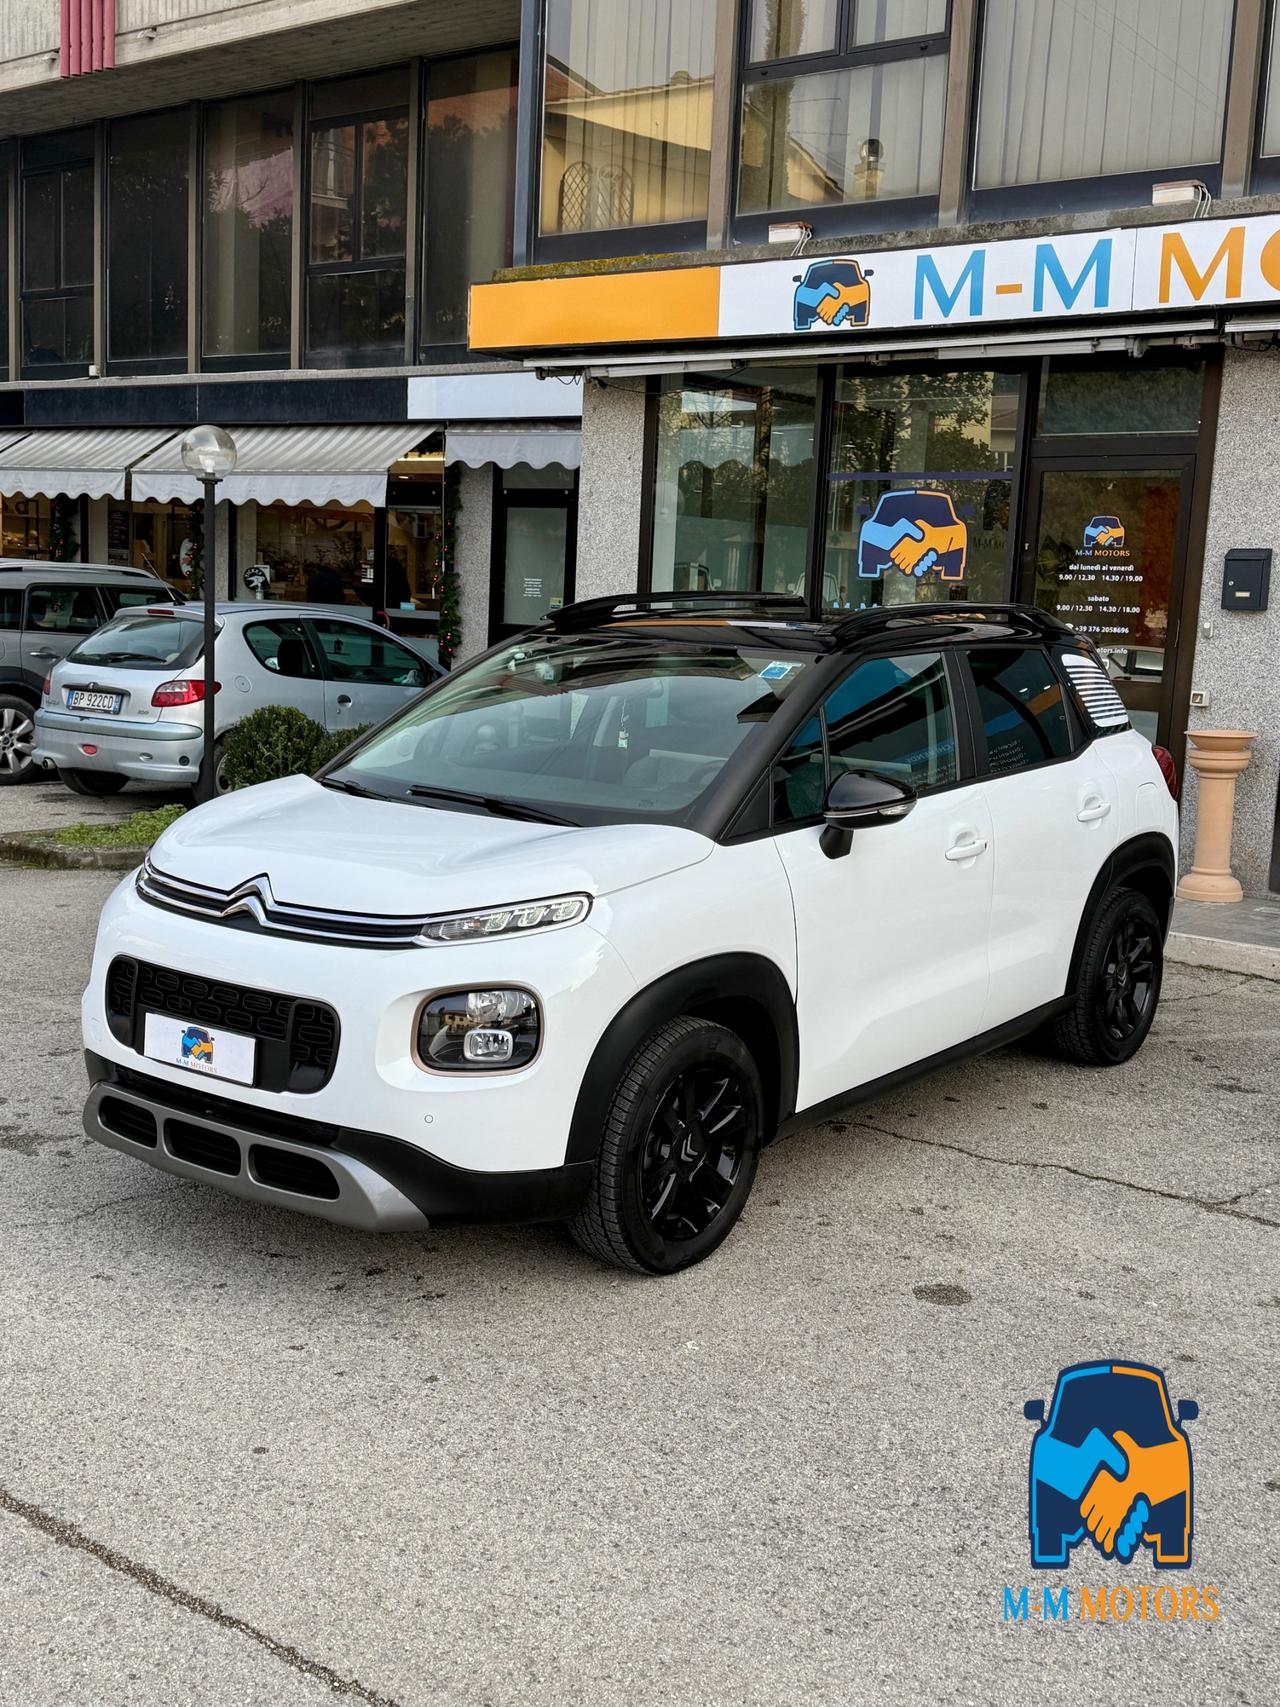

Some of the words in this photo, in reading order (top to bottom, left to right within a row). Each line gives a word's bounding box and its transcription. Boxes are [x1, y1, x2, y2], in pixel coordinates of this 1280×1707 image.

[913, 237, 1113, 320] M-M
[1158, 226, 1280, 304] M
[1094, 549, 1131, 557] MOTORS
[1099, 605, 1116, 613] 14.30
[73, 692, 85, 706] BP
[87, 694, 114, 709] 922CD
